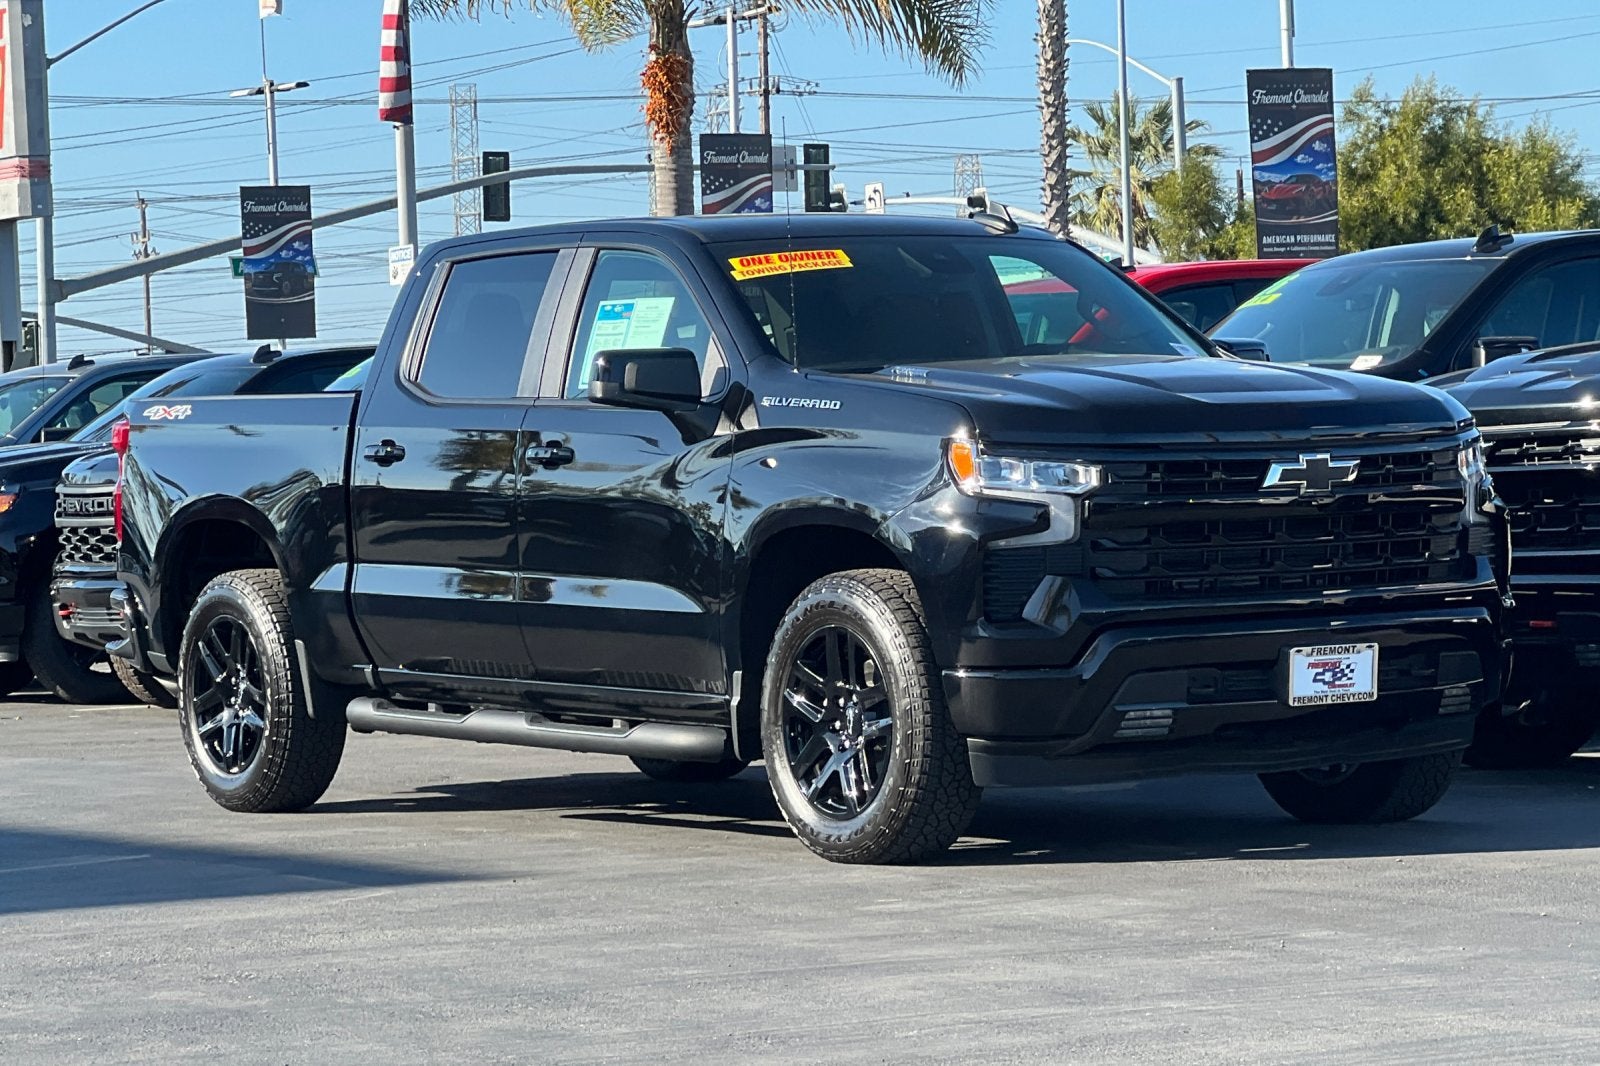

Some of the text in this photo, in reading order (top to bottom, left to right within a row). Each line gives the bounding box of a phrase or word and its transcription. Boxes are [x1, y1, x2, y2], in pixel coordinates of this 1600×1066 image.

[1252, 88, 1329, 105] Fremont Chevrolet
[703, 150, 739, 165] Fremont
[243, 200, 308, 213] Fremont Chevrolet
[1262, 233, 1336, 244] AMERICAN PERFORMANCE
[739, 250, 838, 268] ONE OWNER
[738, 259, 845, 278] TOWING PACKAGE
[761, 396, 841, 410] SILVERADO
[56, 498, 115, 512] CHEVROL
[1310, 645, 1357, 656] FREMONT
[1292, 692, 1375, 705] FREMONT CHEVY.COM
